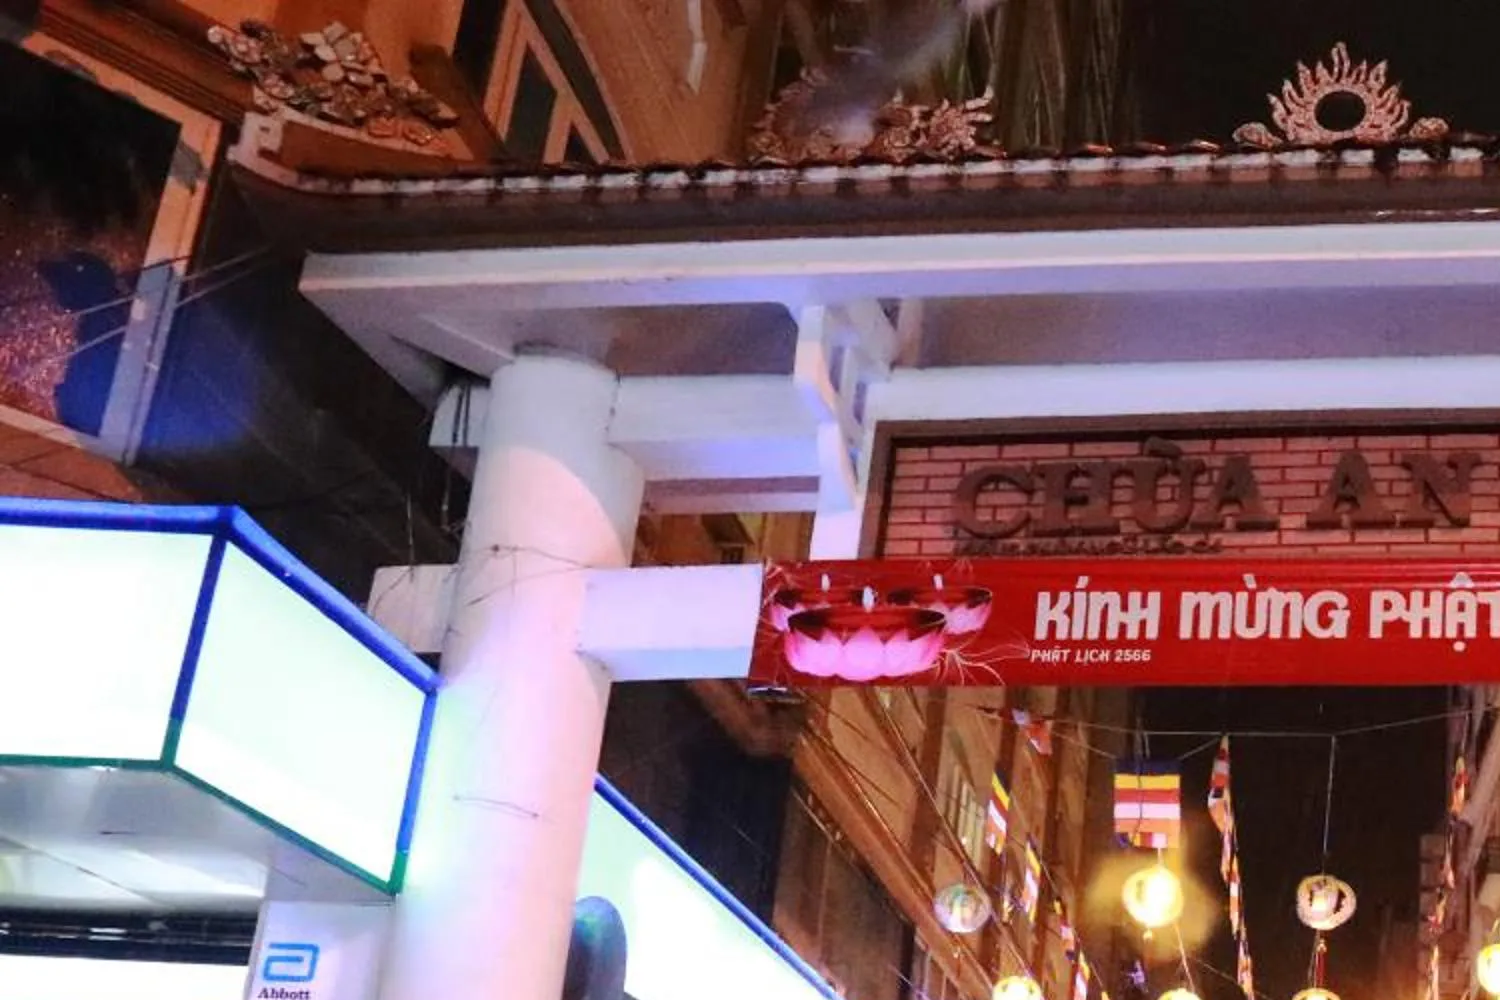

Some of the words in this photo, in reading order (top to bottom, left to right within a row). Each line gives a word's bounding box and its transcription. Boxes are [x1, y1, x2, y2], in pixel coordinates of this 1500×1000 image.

[954, 436, 1281, 539] CHÙA
[1306, 449, 1481, 527] AN
[1034, 576, 1161, 640] KÍNH
[1179, 574, 1350, 639] MỪNG
[1115, 648, 1151, 663] 2566
[258, 987, 310, 1000] Abbott
